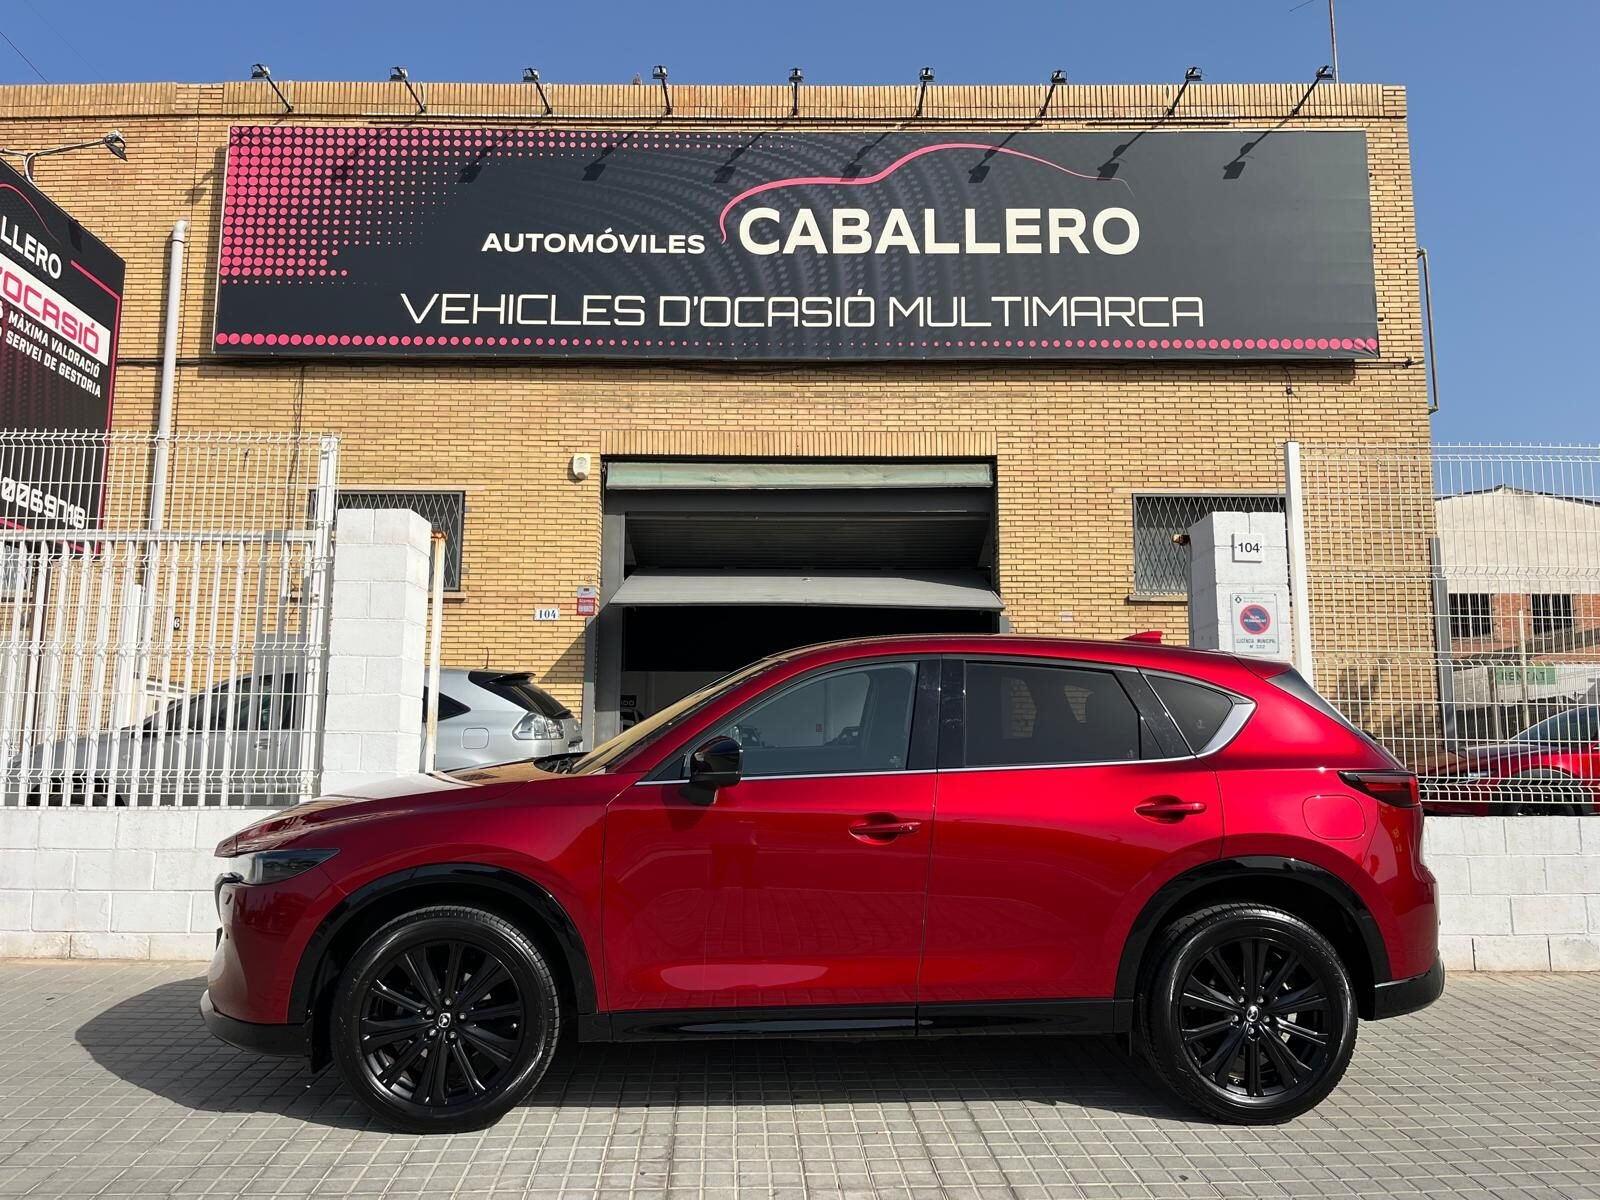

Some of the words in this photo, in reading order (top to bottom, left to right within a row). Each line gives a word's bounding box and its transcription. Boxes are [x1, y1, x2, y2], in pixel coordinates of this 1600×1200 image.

[0, 215, 62, 279] LLERO
[482, 228, 705, 254] AUTOMÓVILES
[738, 207, 1140, 255] CABALLERO
[400, 293, 645, 326] VEHICLES
[658, 289, 875, 328] D'OCASIÓ
[5, 330, 42, 362] SERVEI
[43, 353, 58, 372] DE
[58, 363, 101, 398] GESTORIA
[8, 311, 49, 347] MÀXIMA
[51, 337, 100, 378] VALORACIÓ
[1238, 542, 1260, 553] 104
[539, 609, 556, 619] 104
